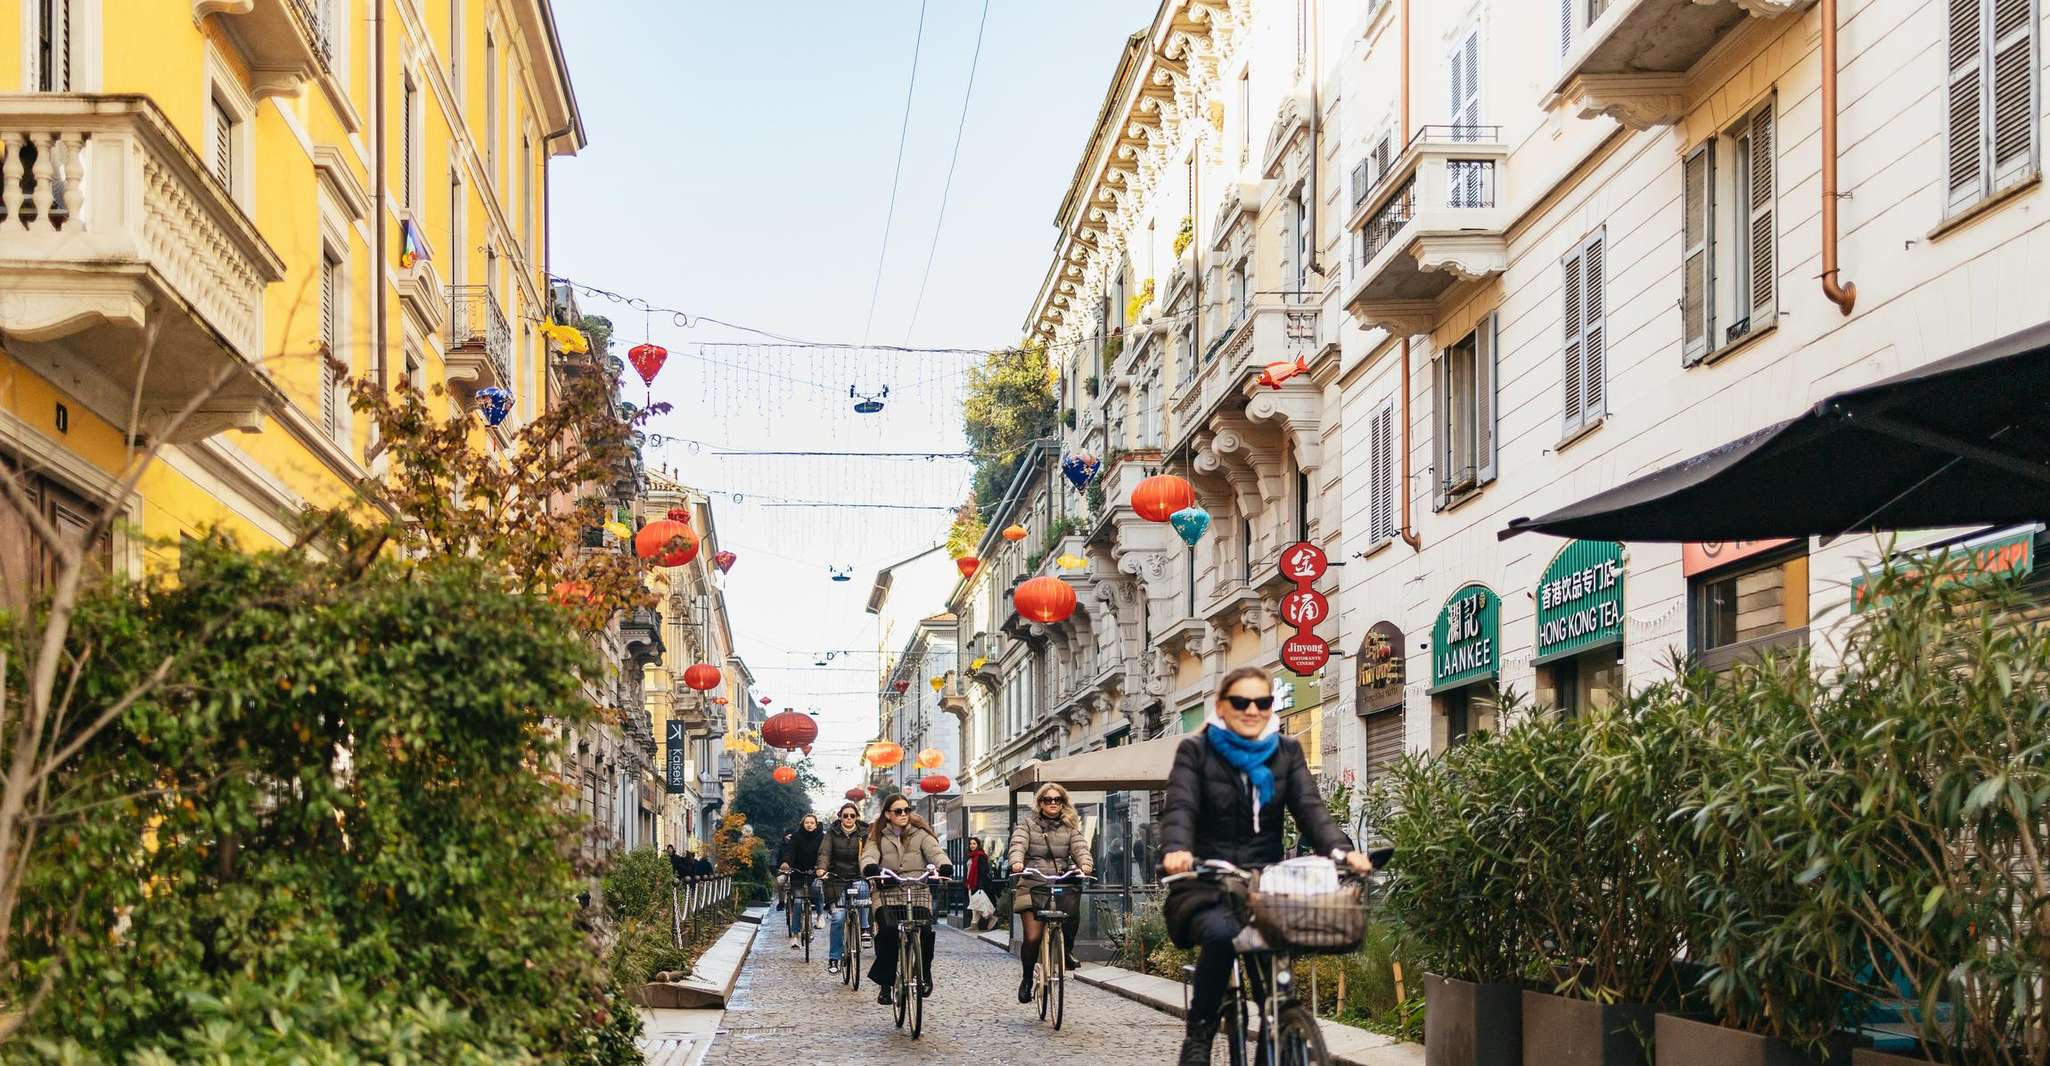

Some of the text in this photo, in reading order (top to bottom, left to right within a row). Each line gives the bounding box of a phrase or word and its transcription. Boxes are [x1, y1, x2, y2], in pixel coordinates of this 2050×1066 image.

[1541, 558, 1616, 611] 香港饮品专门店
[1539, 599, 1619, 647] HONG KONG TEA
[1287, 642, 1324, 655] Jinyong
[1437, 638, 1490, 679] LAANKEE
[668, 724, 682, 740] K
